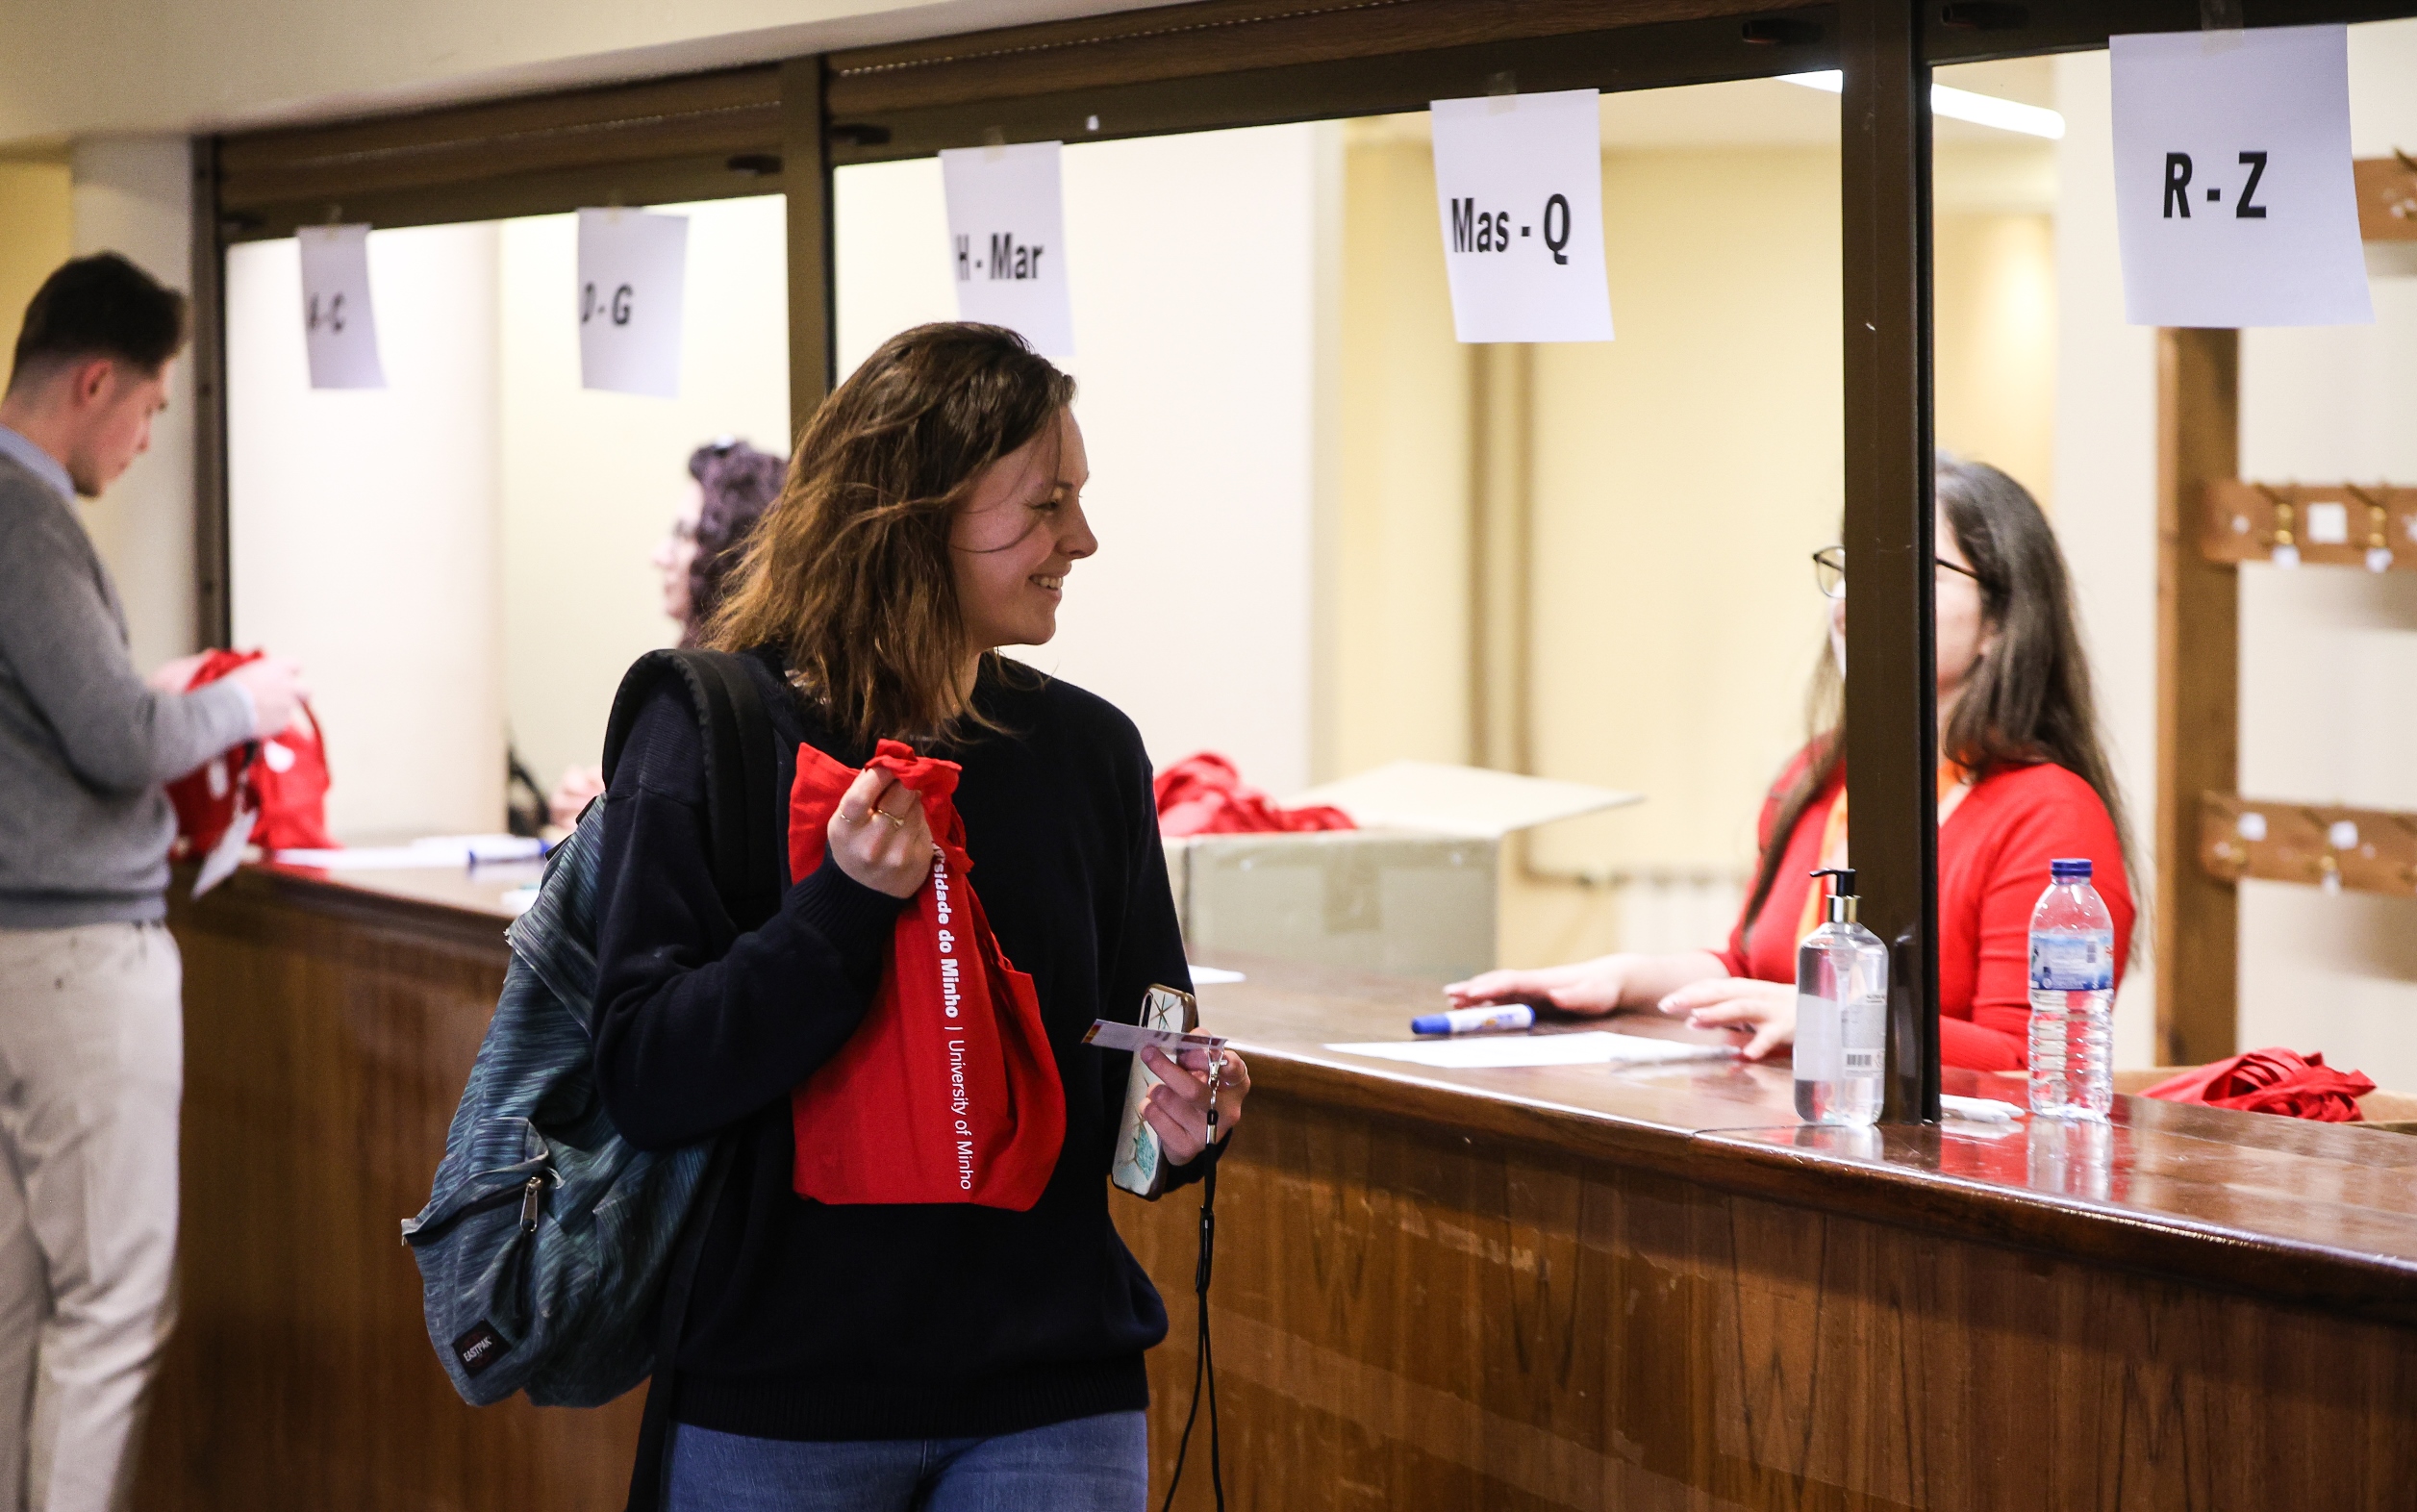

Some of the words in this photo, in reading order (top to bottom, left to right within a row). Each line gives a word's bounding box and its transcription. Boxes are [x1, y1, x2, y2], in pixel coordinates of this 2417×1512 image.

[2163, 151, 2193, 218] R
[2206, 188, 2221, 202] -
[2236, 150, 2268, 218] Z
[1451, 197, 1510, 253] Mas
[1544, 192, 1571, 265] Q
[990, 231, 1045, 280] Mar
[612, 284, 634, 326] G
[938, 929, 955, 954] do
[940, 958, 961, 1019] Minho
[948, 1040, 969, 1116] University
[955, 1120, 972, 1136] of
[956, 1141, 974, 1191] Minho
[463, 1336, 492, 1362] EASTPAK
